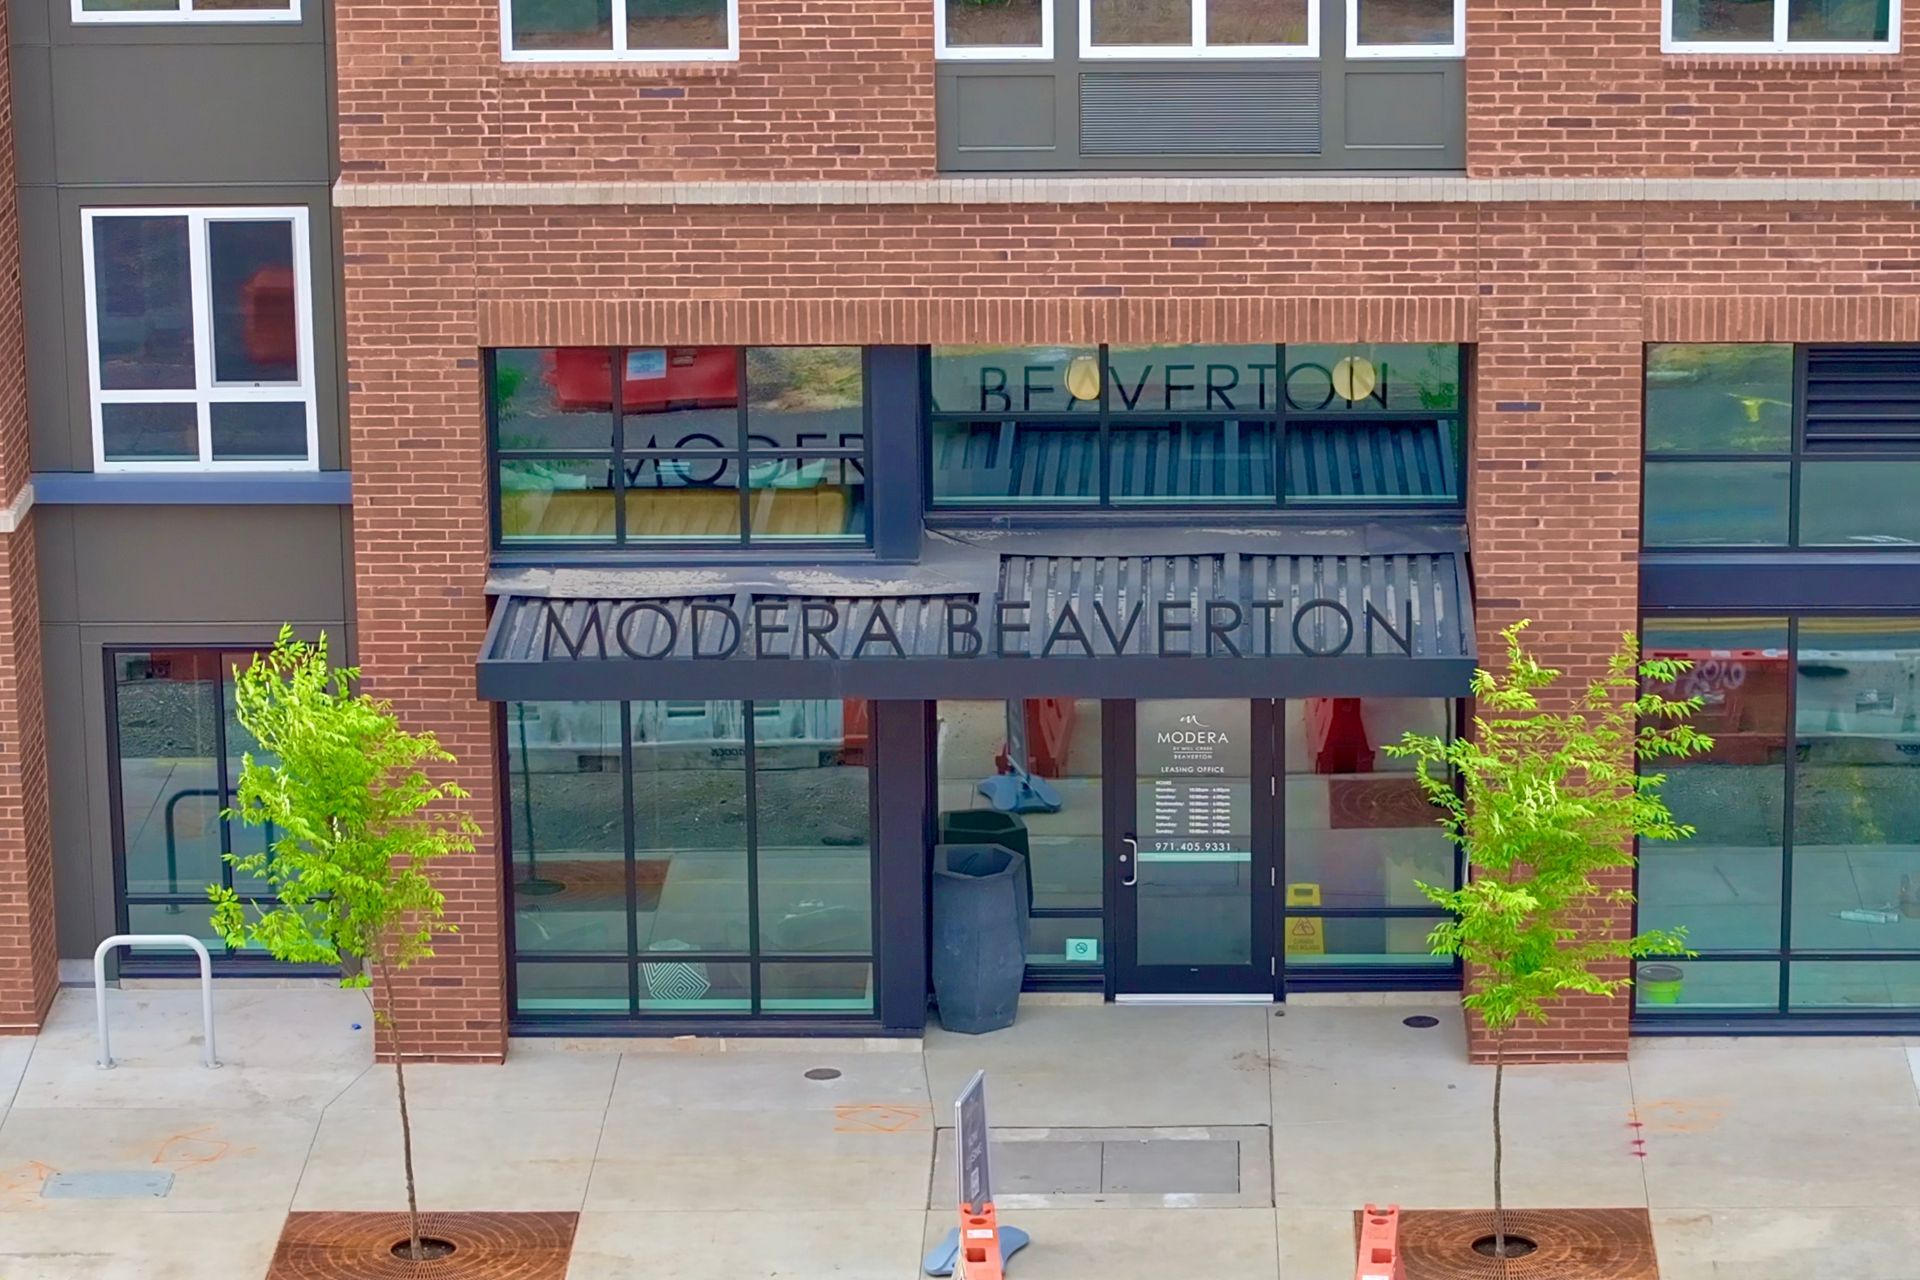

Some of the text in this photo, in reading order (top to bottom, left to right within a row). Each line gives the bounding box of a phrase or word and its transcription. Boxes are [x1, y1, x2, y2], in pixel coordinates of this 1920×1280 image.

[542, 600, 1413, 660] MODERA BEAVERTON
[1157, 731, 1229, 744] MODERA
[1155, 842, 1231, 852] 971.405.9331
